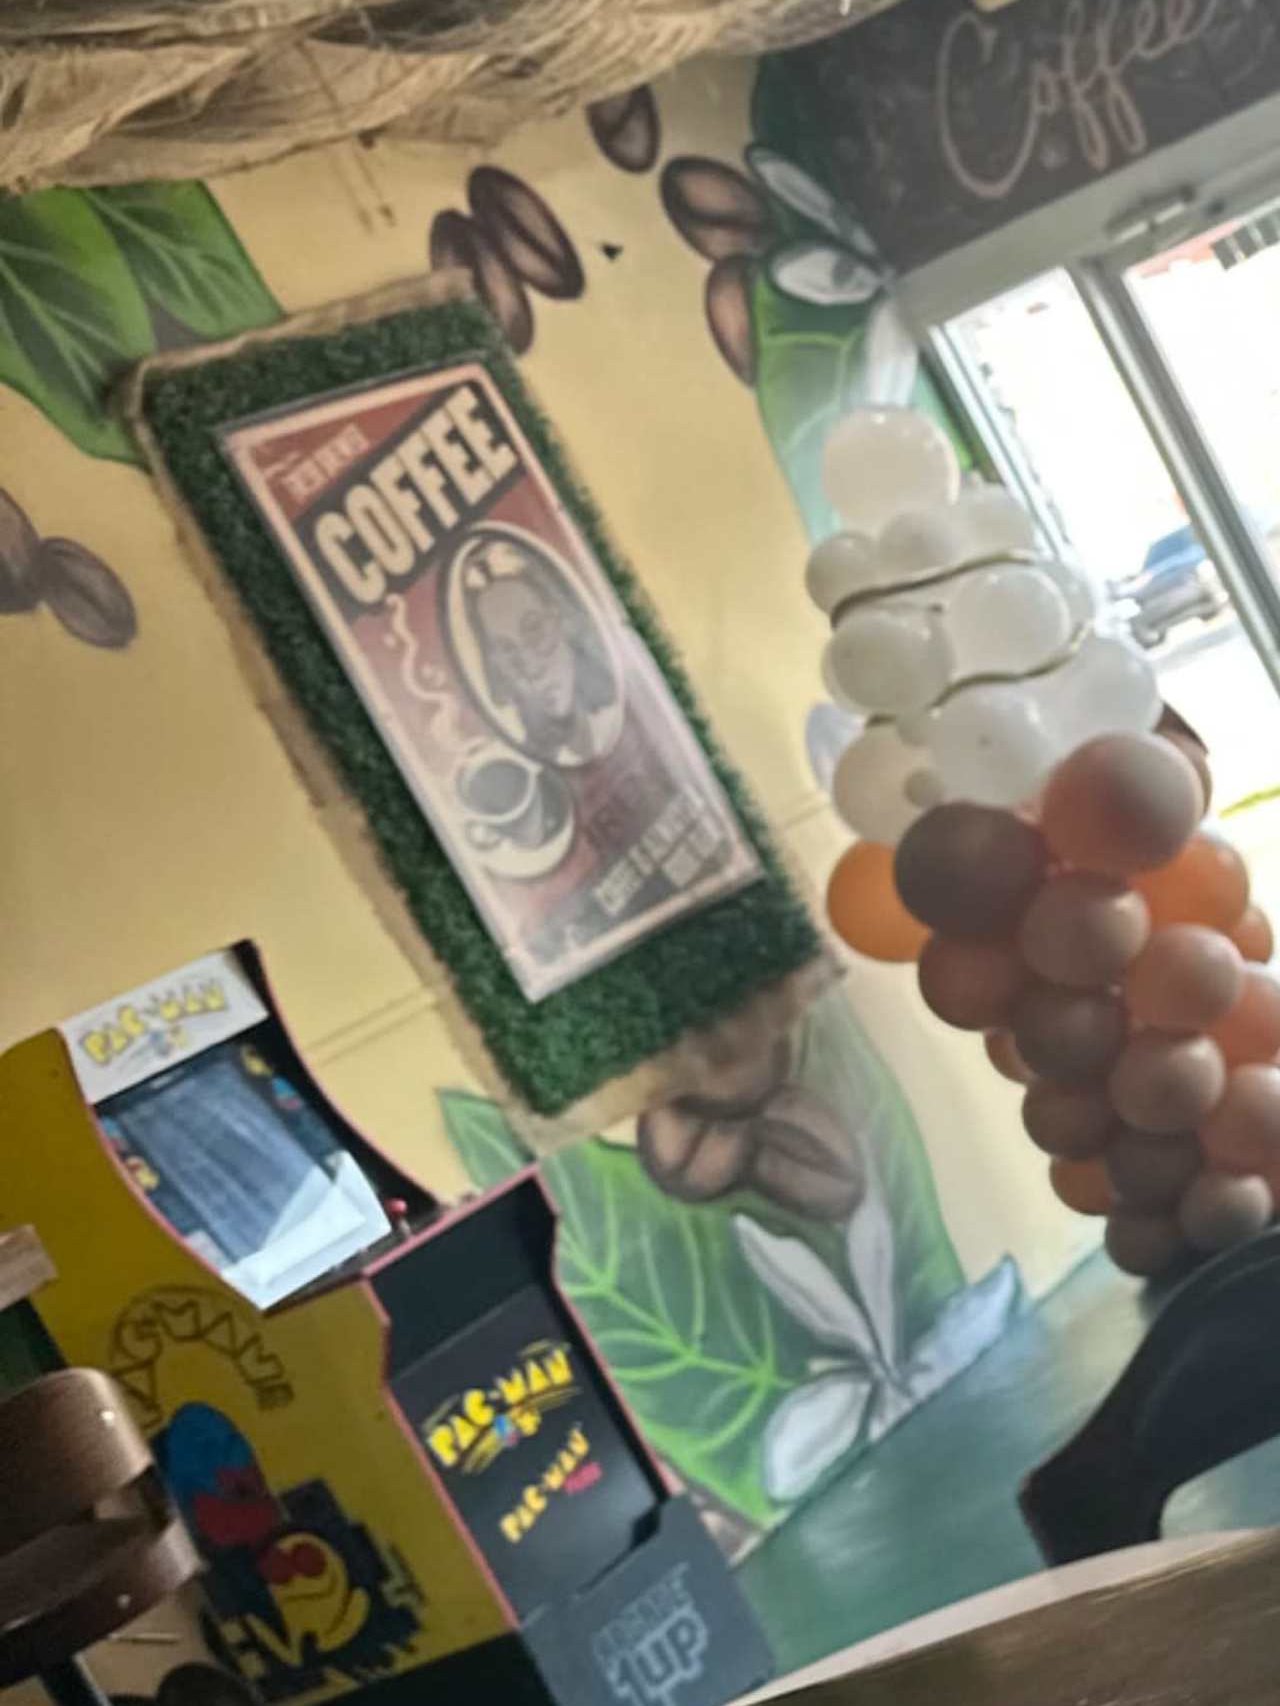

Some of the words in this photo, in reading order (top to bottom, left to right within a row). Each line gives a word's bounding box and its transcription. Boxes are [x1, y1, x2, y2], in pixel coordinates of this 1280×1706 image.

[314, 385, 517, 607] COFFEE
[78, 977, 230, 1068] PAC-MAN
[428, 1345, 577, 1467] PAC-MAN
